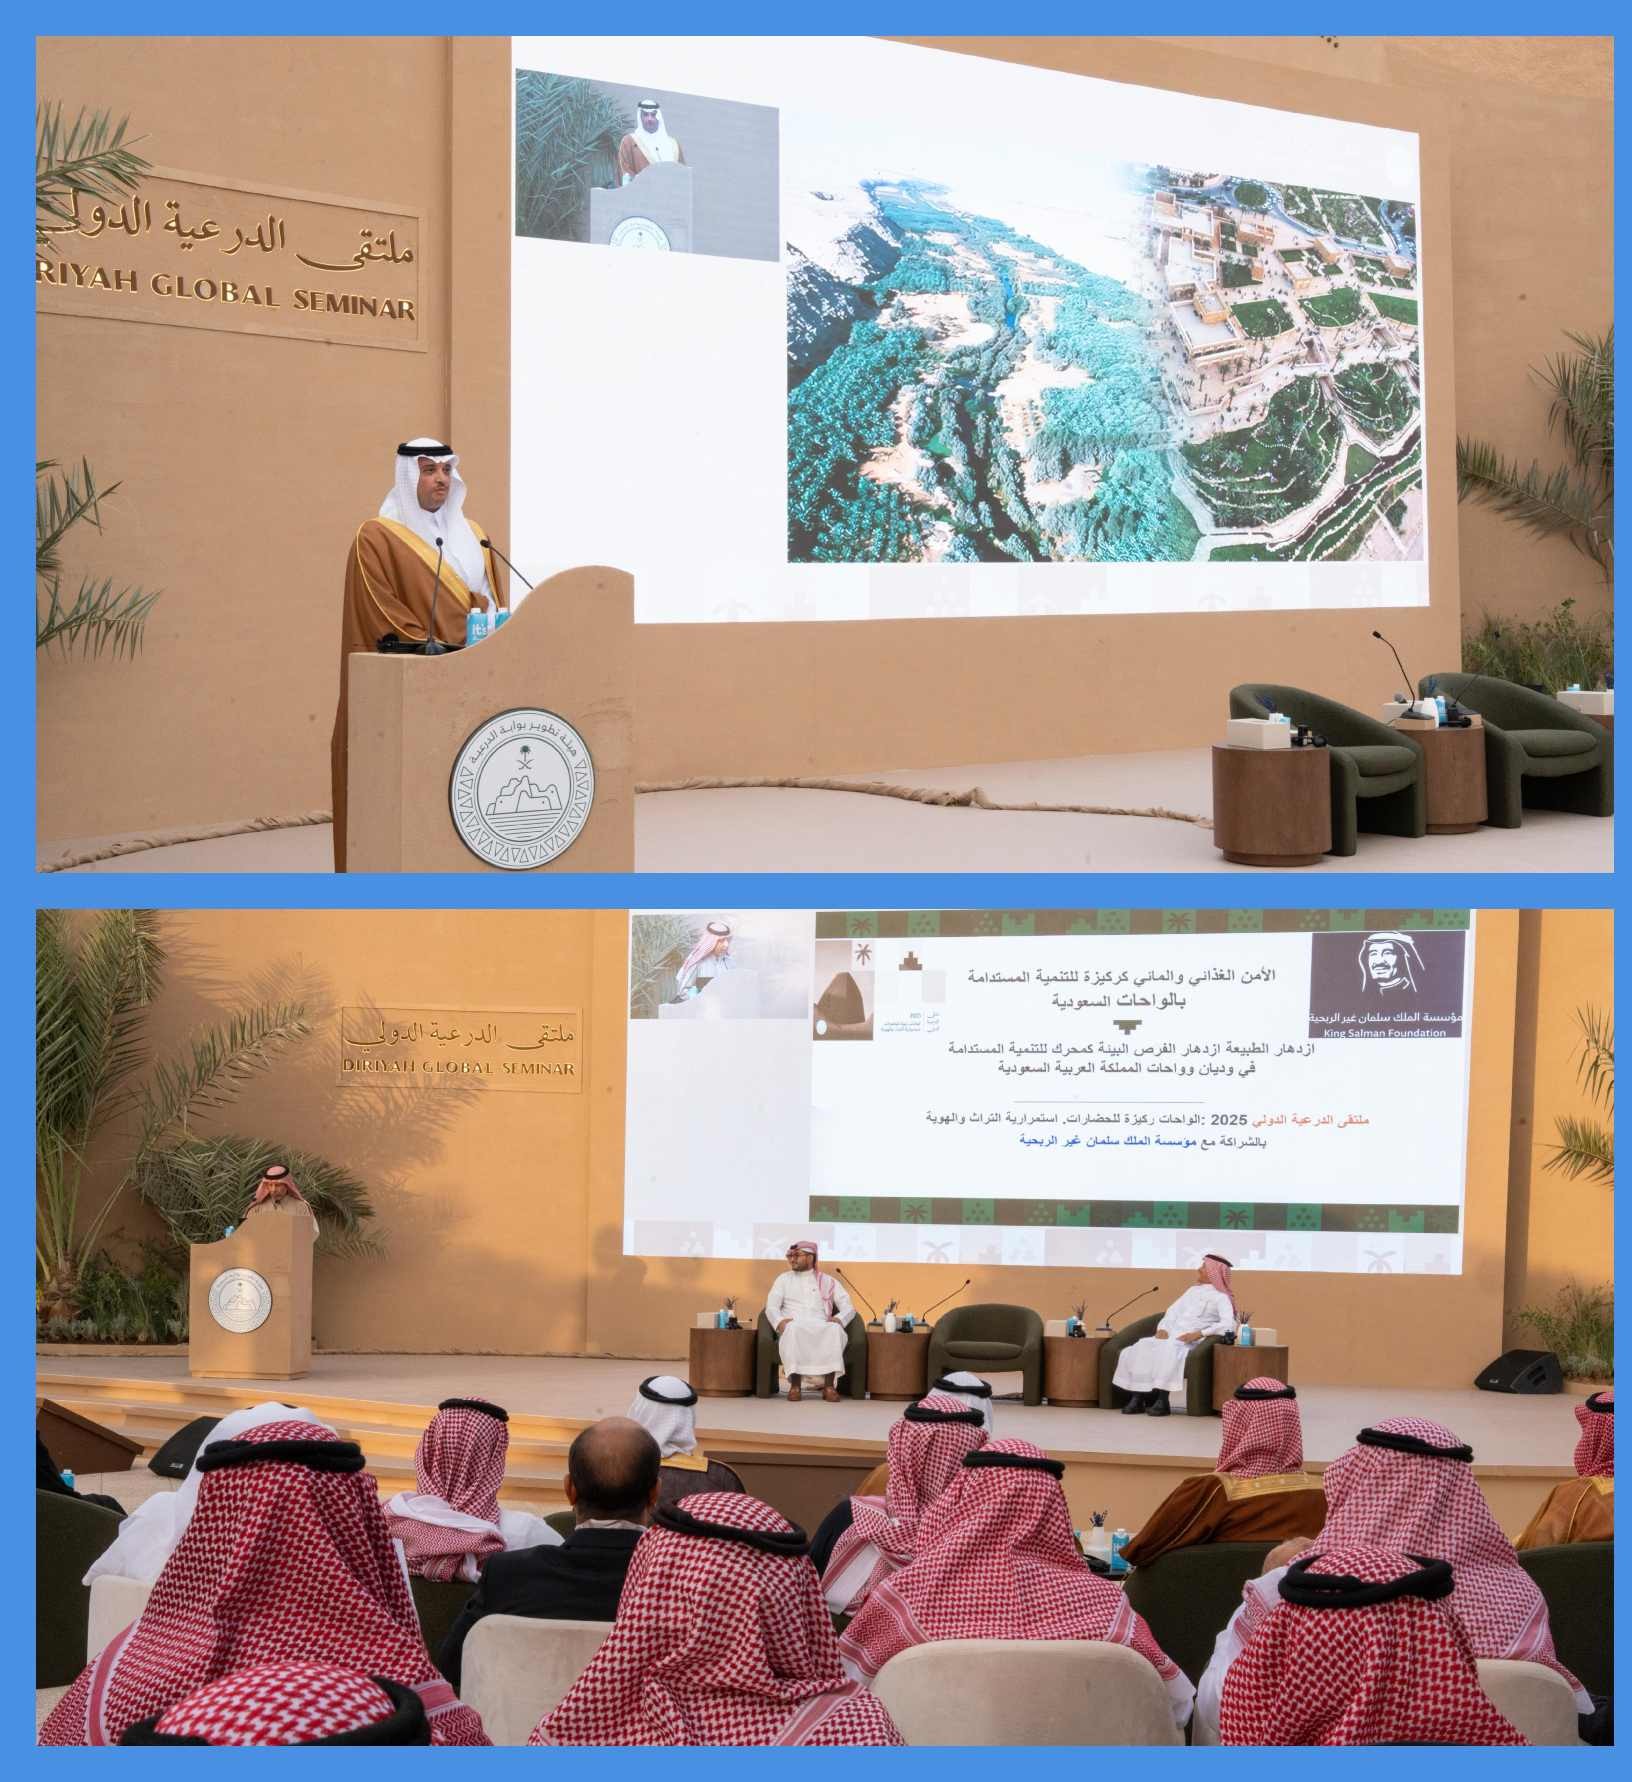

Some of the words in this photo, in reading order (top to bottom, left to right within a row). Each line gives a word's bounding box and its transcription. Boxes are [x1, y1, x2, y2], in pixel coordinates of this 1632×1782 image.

[164, 198, 286, 255] الدرعية
[295, 229, 414, 272] ملتقى
[151, 273, 280, 308] GLOBAL
[293, 288, 415, 321] SEMINAR
[967, 968, 1030, 983] المستدامة
[1035, 968, 1079, 986] للتنمية
[1083, 969, 1128, 986] كركيزة
[1241, 966, 1276, 985] الأمن
[1052, 992, 1111, 1010] السعودية
[1116, 991, 1186, 1010] بالواحات
[1341, 1012, 1356, 1024] غير
[1358, 1012, 1391, 1024] سلمان
[1393, 1012, 1420, 1023] الملك
[344, 1016, 423, 1054] الدولي
[430, 1022, 497, 1046] الدرعية
[506, 1024, 574, 1050] ملتقى
[1324, 1028, 1346, 1038] King
[1348, 1028, 1385, 1038] Salman
[1388, 1028, 1447, 1038] Foundation
[948, 1041, 1004, 1055] المستدامة
[1009, 1041, 1048, 1056] للتنمية
[1051, 1042, 1094, 1057] كمحرك
[1134, 1042, 1176, 1056] الفرص
[1226, 1040, 1269, 1056] الطبيعة
[343, 1058, 415, 1073] DIRIYAH
[423, 1061, 494, 1074] GLOBAL
[503, 1062, 575, 1076] SEMINAR
[998, 1060, 1050, 1076] السعودية
[1055, 1060, 1095, 1076] العربية
[1100, 1060, 1141, 1075] المملكة
[1198, 1062, 1234, 1076] وديان
[1238, 1060, 1256, 1077] في
[969, 1112, 1001, 1125] التراث
[1005, 1112, 1058, 1125] استمرارية
[1211, 1114, 1248, 1126] 2025
[1252, 1114, 1287, 1128] الدولي
[1291, 1113, 1334, 1127] الدرعية
[1337, 1113, 1370, 1128] ملتقى
[1086, 1135, 1120, 1147] سلمان
[1123, 1135, 1151, 1146] الملك
[1200, 1137, 1216, 1150] مع
